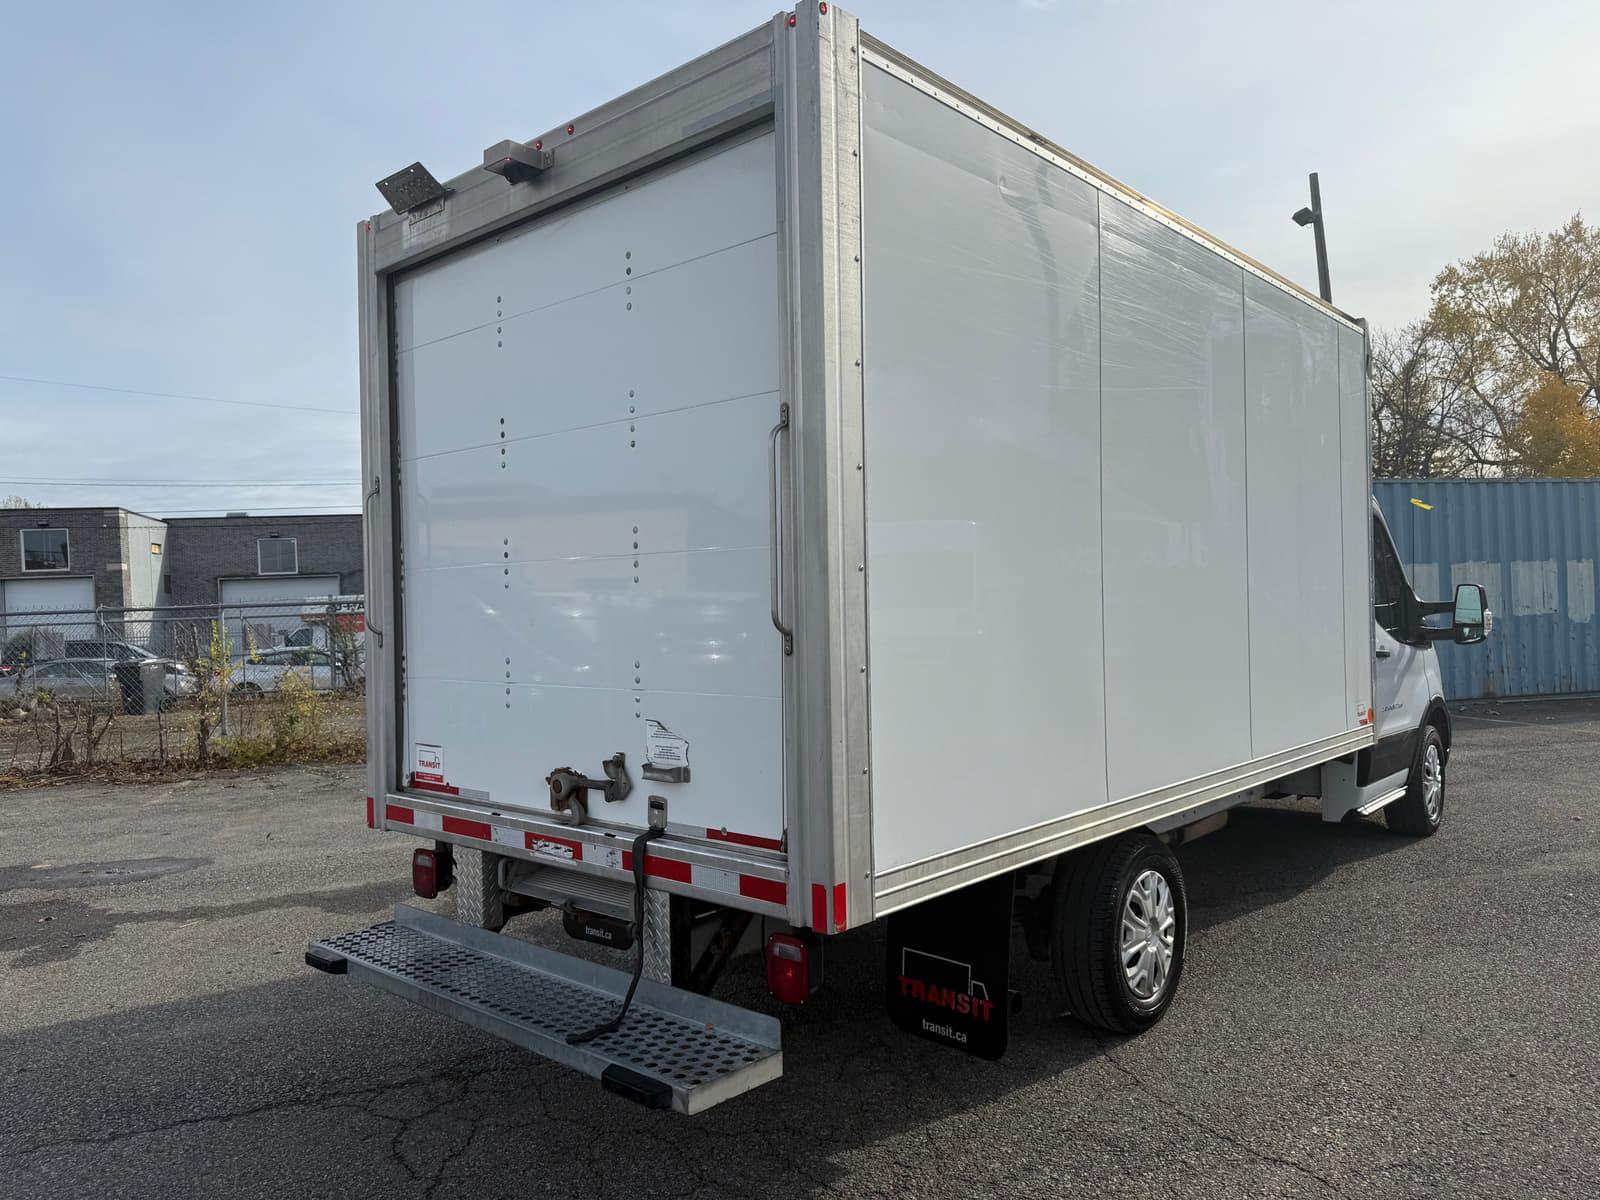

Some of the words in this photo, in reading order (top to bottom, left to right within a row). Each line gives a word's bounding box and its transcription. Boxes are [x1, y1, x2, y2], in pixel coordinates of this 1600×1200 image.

[418, 759, 441, 769] TRANSIT
[585, 925, 612, 940] transit.ca
[898, 976, 993, 1021] TRANSIT
[922, 1018, 967, 1043] transit.ca
